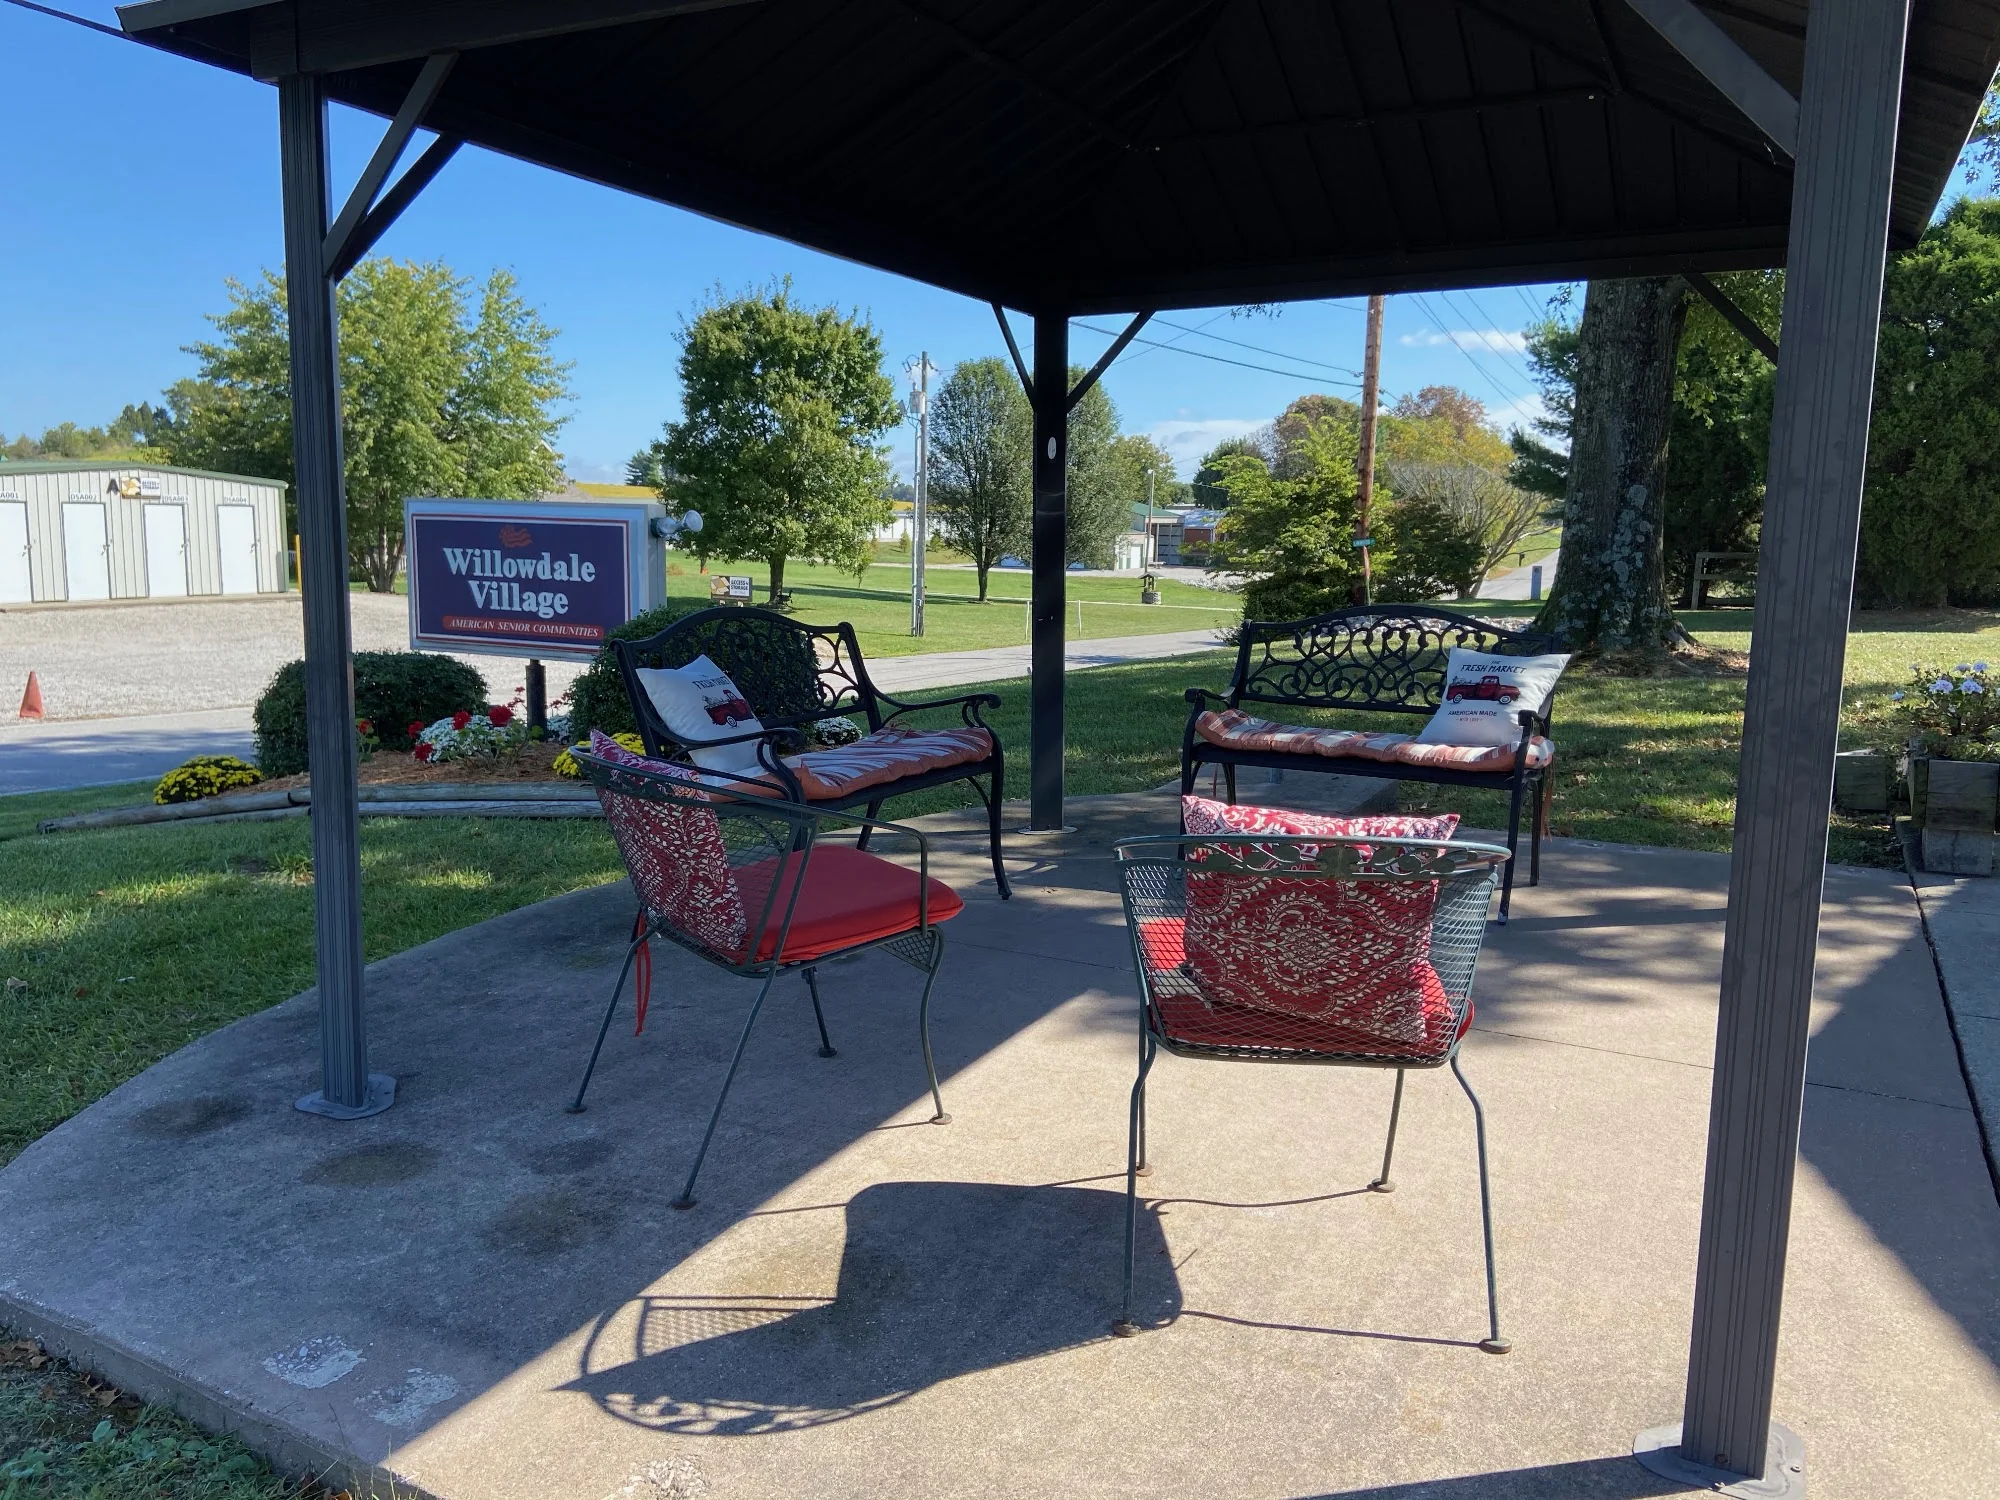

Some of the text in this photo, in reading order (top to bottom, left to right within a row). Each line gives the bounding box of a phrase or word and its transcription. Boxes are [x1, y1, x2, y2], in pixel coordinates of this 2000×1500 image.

[106, 478, 120, 495] A
[443, 547, 596, 583] Willowdale
[468, 580, 569, 619] Village
[449, 619, 599, 637] AMERICAN SENIOR COMMUNITIES
[1461, 664, 1527, 674] FRESH MARKET
